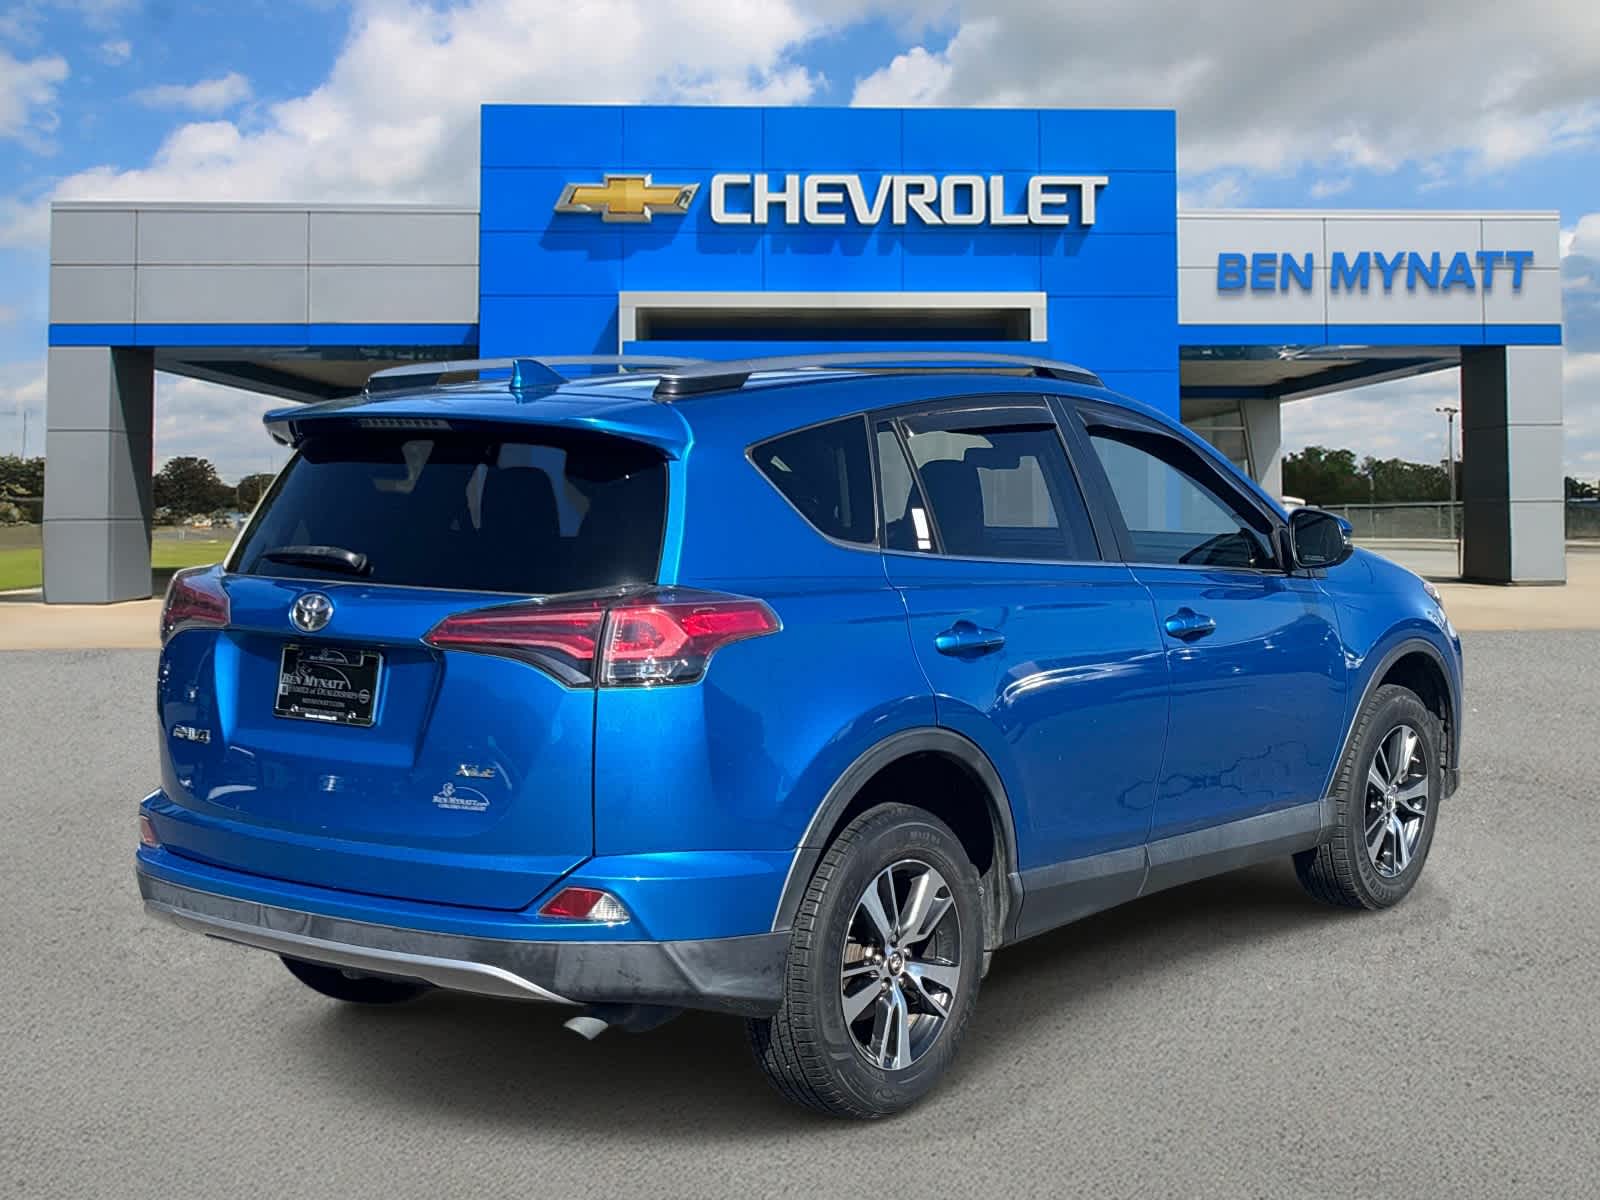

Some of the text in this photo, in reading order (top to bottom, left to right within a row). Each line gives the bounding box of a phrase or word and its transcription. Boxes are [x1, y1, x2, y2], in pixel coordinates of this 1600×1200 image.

[710, 173, 1110, 226] CHEVROLET
[1217, 251, 1534, 291] BEN MYNATT
